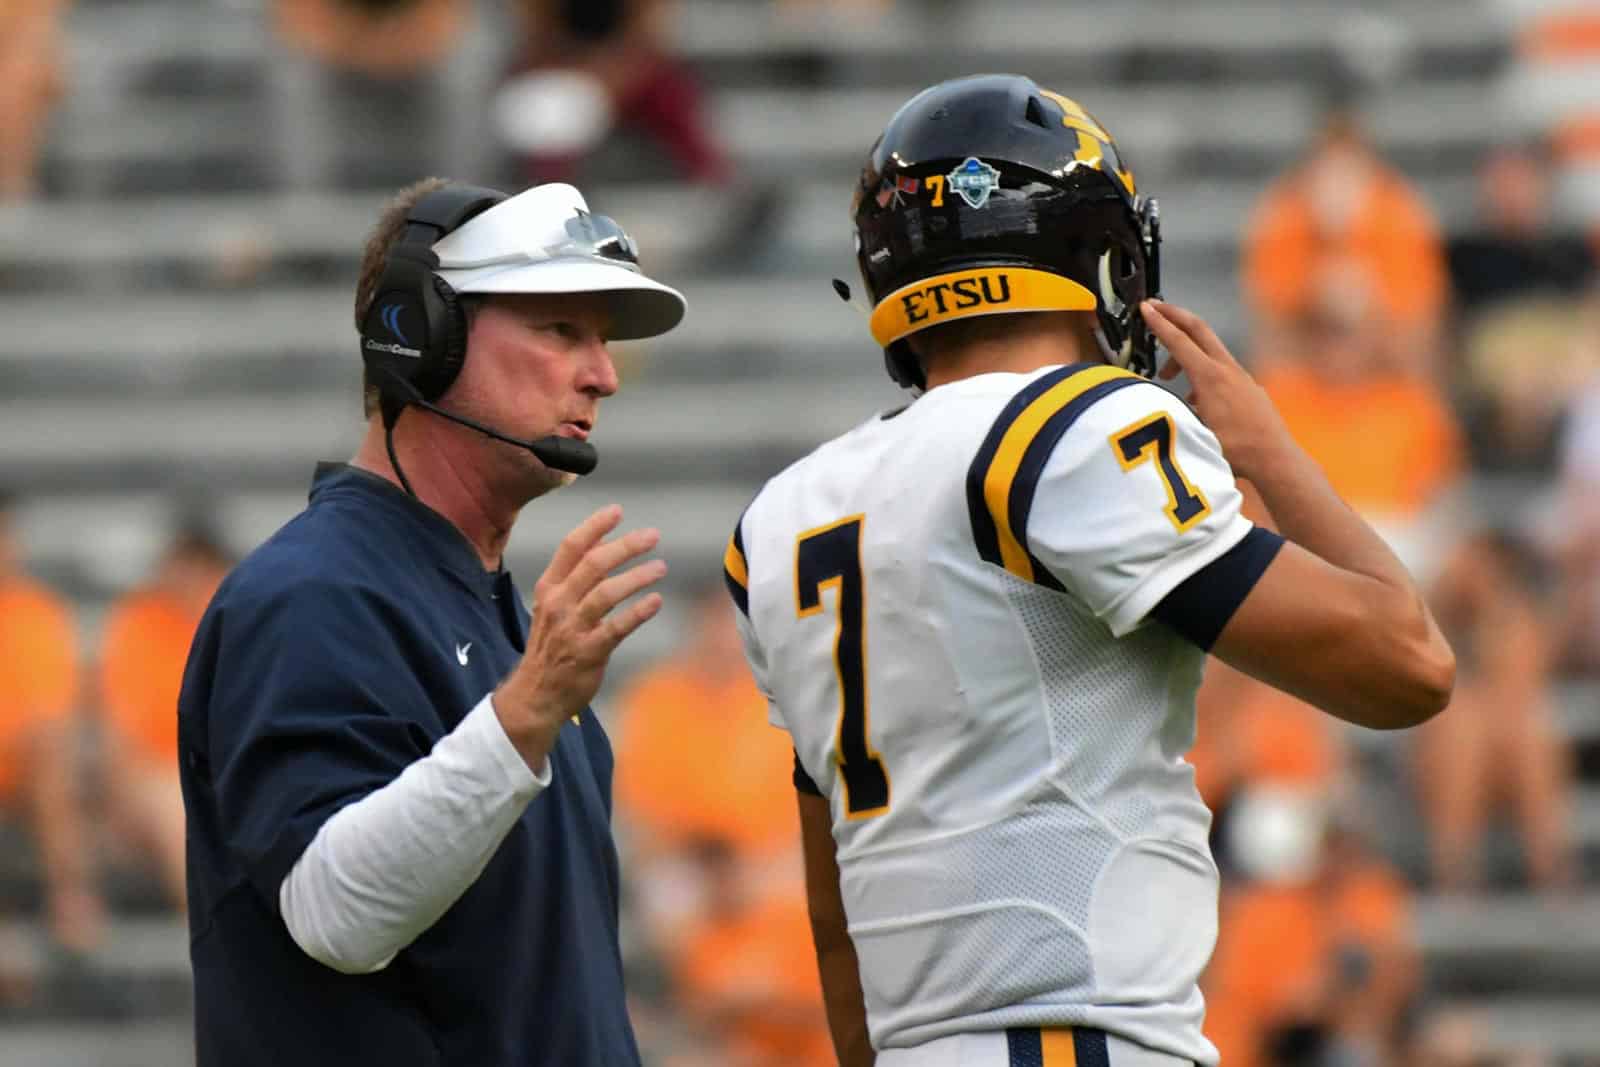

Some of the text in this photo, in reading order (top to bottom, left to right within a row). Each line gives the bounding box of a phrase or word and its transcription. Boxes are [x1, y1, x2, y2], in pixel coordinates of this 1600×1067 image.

[925, 174, 945, 208] 7
[901, 275, 1010, 324] ETSU
[1107, 410, 1212, 536] 7
[794, 512, 892, 821] 7
